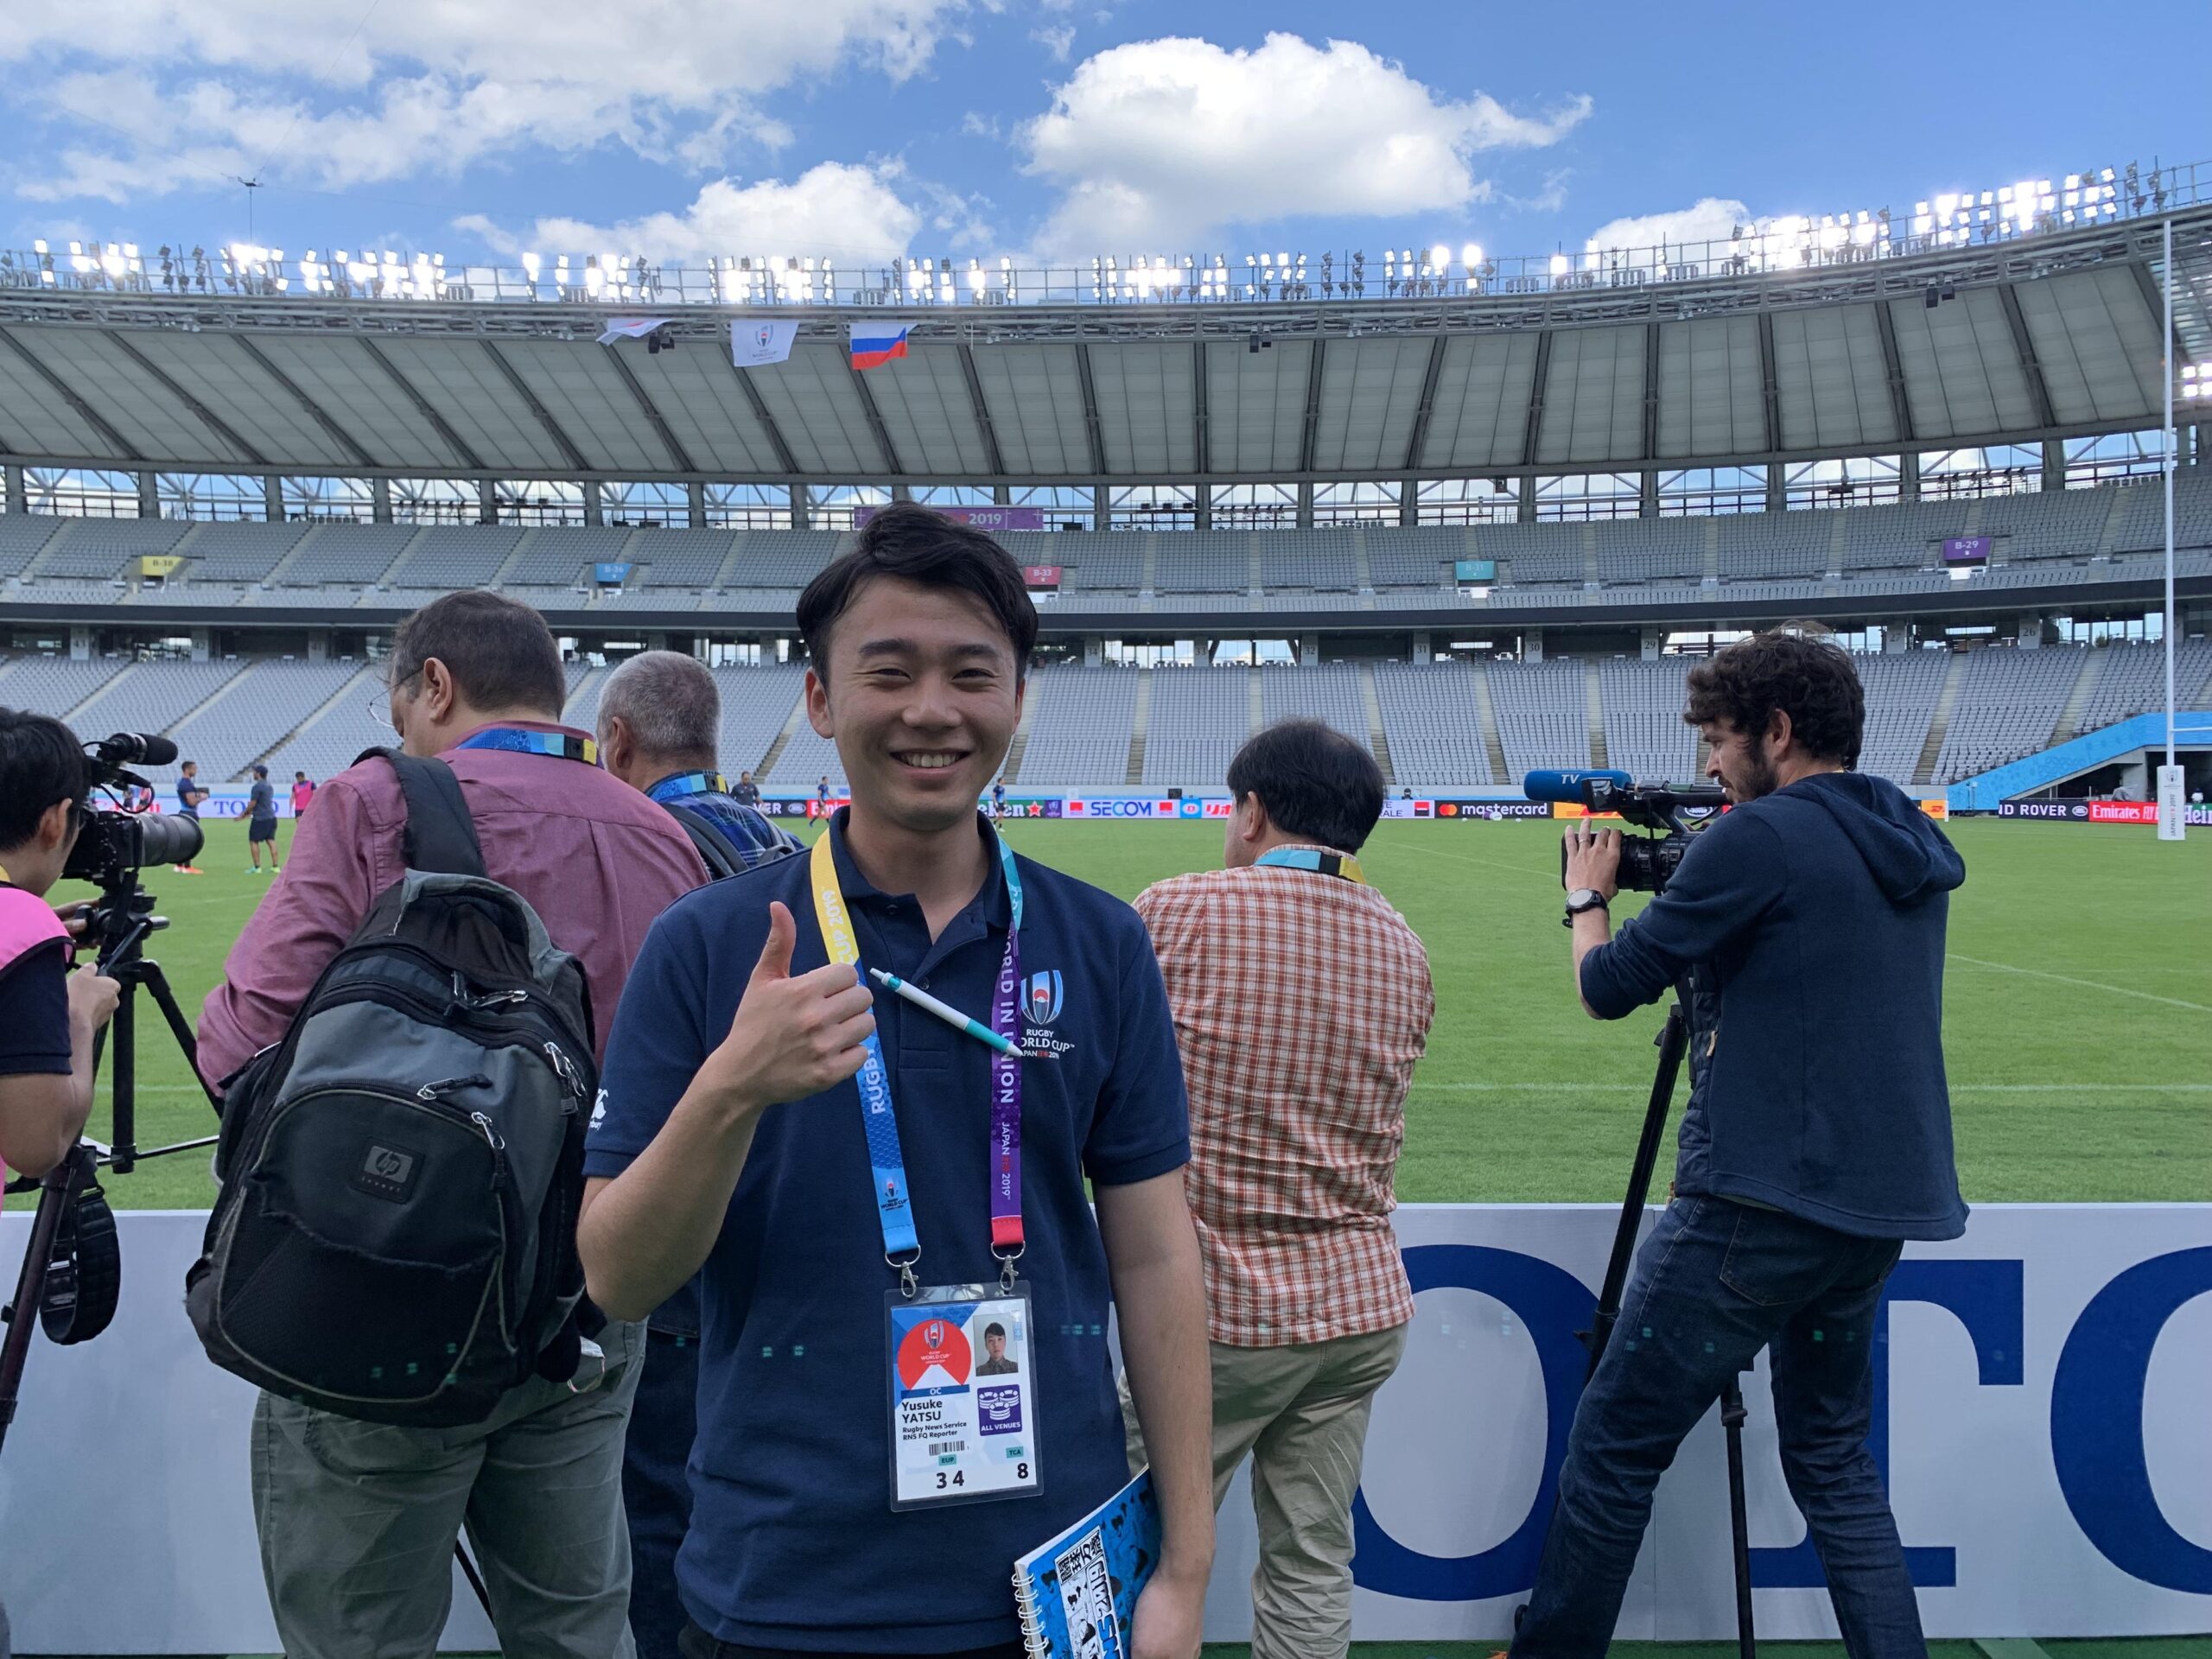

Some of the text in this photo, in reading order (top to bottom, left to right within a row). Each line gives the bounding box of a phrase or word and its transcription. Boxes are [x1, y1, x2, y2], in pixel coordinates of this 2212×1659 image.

[969, 513, 1001, 524] 2019
[1955, 541, 1979, 550] B-29
[2023, 627, 2036, 637] 26
[1890, 633, 1901, 643] 27
[1305, 646, 1315, 655] 32
[1417, 645, 1427, 653] 31
[1529, 643, 1540, 652] 30
[1644, 640, 1656, 650] 29
[1088, 648, 1098, 657] 34
[1196, 647, 1206, 656] 33
[1561, 774, 1580, 784] TV
[1091, 801, 1151, 816] SECOM
[1462, 803, 1548, 816] mastercard
[2020, 804, 2067, 816] ROVER
[2092, 804, 2140, 819] Emirates
[823, 889, 844, 926] 2019
[1001, 1001, 1014, 1023] IN
[1027, 1029, 1054, 1038] RUGBY
[1020, 1037, 1051, 1048] ORLD
[1001, 1122, 1010, 1155] JAPAN
[902, 1399, 943, 1412] Yusuke
[902, 1410, 941, 1423] YATSU
[929, 1430, 957, 1439] Reporter
[1017, 1462, 1028, 1479] 8
[1087, 1560, 1112, 1618] 2019
